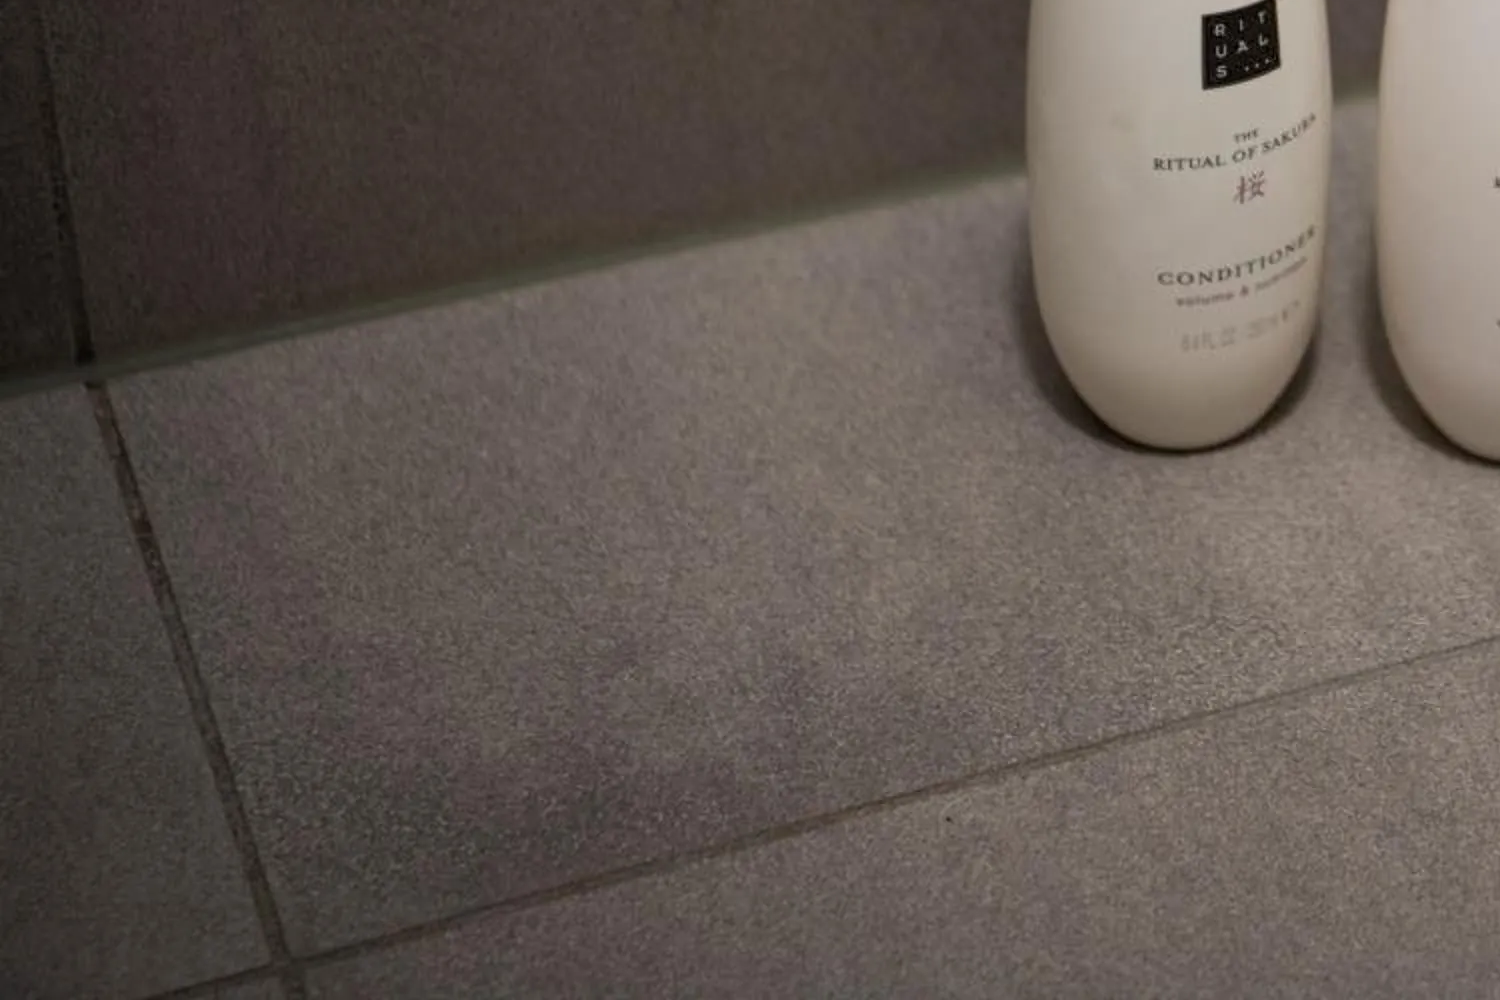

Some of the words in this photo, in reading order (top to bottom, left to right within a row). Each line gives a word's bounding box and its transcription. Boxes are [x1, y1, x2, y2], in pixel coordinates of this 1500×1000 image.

[1153, 154, 1227, 172] RITUAL
[1231, 144, 1258, 163] OF
[1260, 112, 1318, 154] SAKURA
[1233, 127, 1260, 144] THE
[1156, 223, 1319, 286] CONDITIONER
